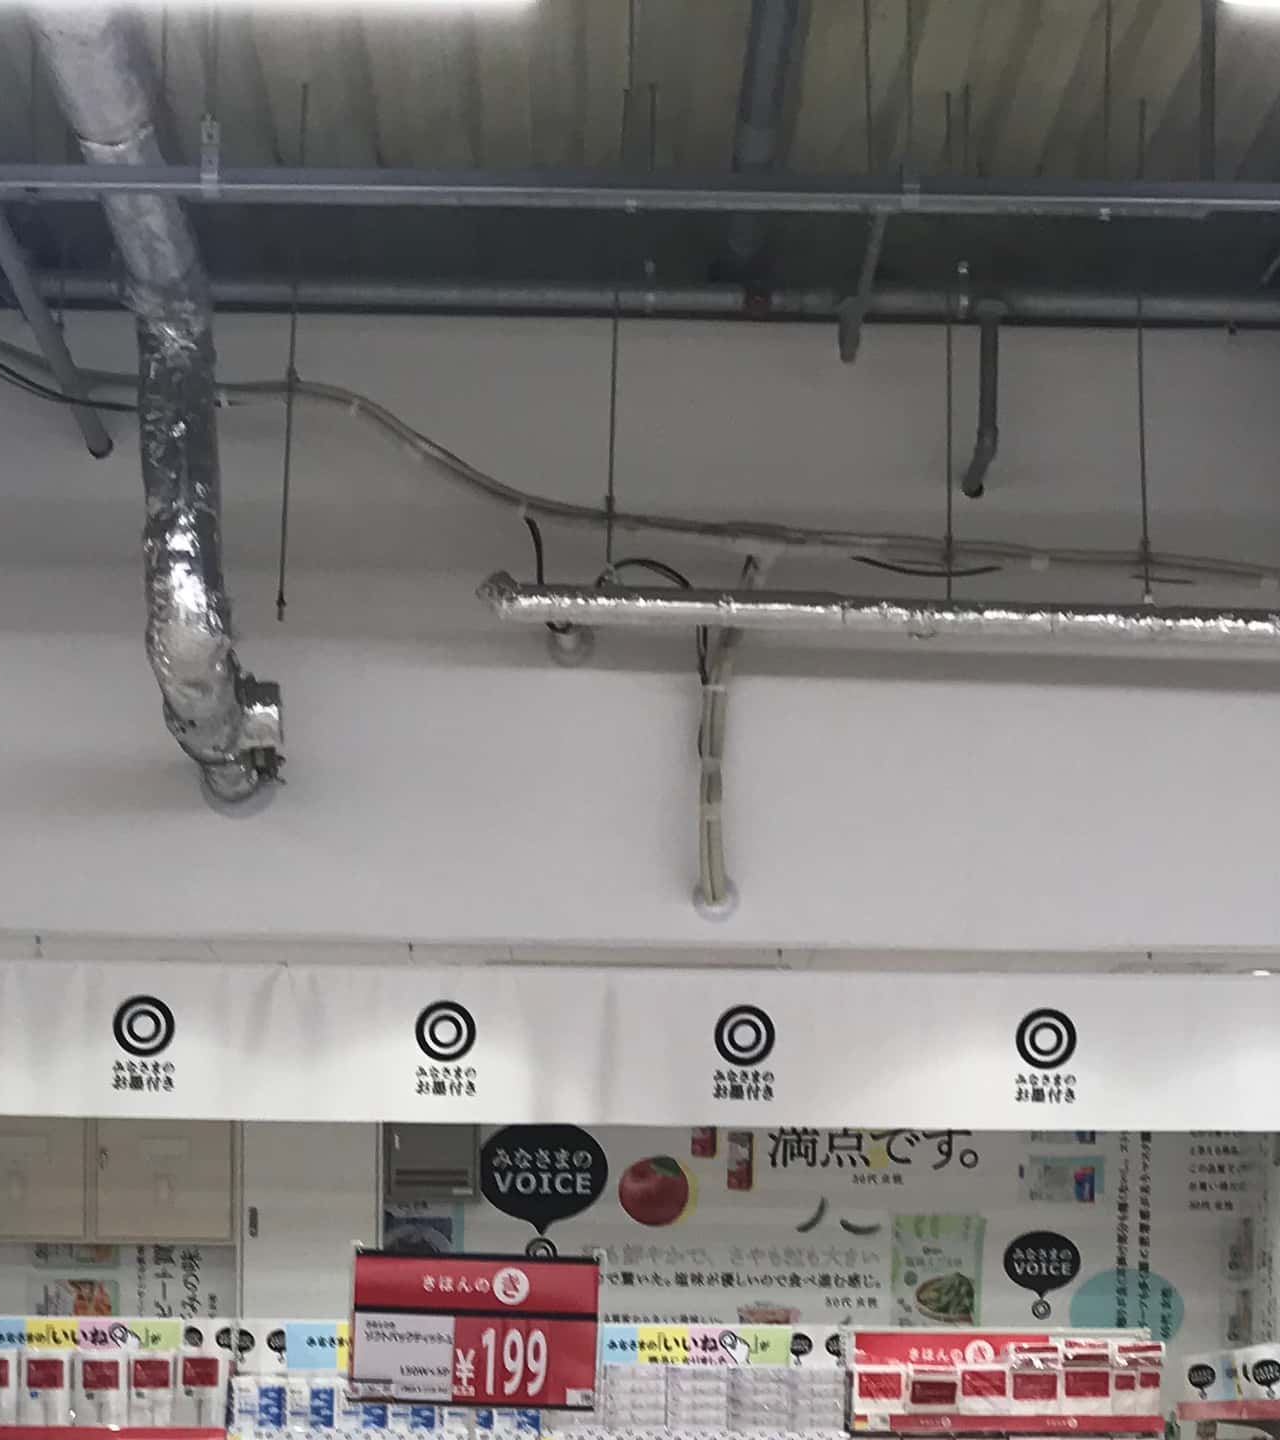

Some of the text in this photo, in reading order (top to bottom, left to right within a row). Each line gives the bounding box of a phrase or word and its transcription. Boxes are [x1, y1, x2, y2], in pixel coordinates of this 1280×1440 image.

[112, 1076, 176, 1092] お墨付き
[414, 1081, 478, 1097] お墨付き
[713, 1085, 776, 1101] お墨付き
[1015, 1089, 1077, 1105] お墨付き
[768, 1126, 979, 1170] 満点です。
[492, 1148, 593, 1169] みなさまの
[493, 1172, 593, 1194] VOICE
[1013, 1262, 1073, 1277] VOICE
